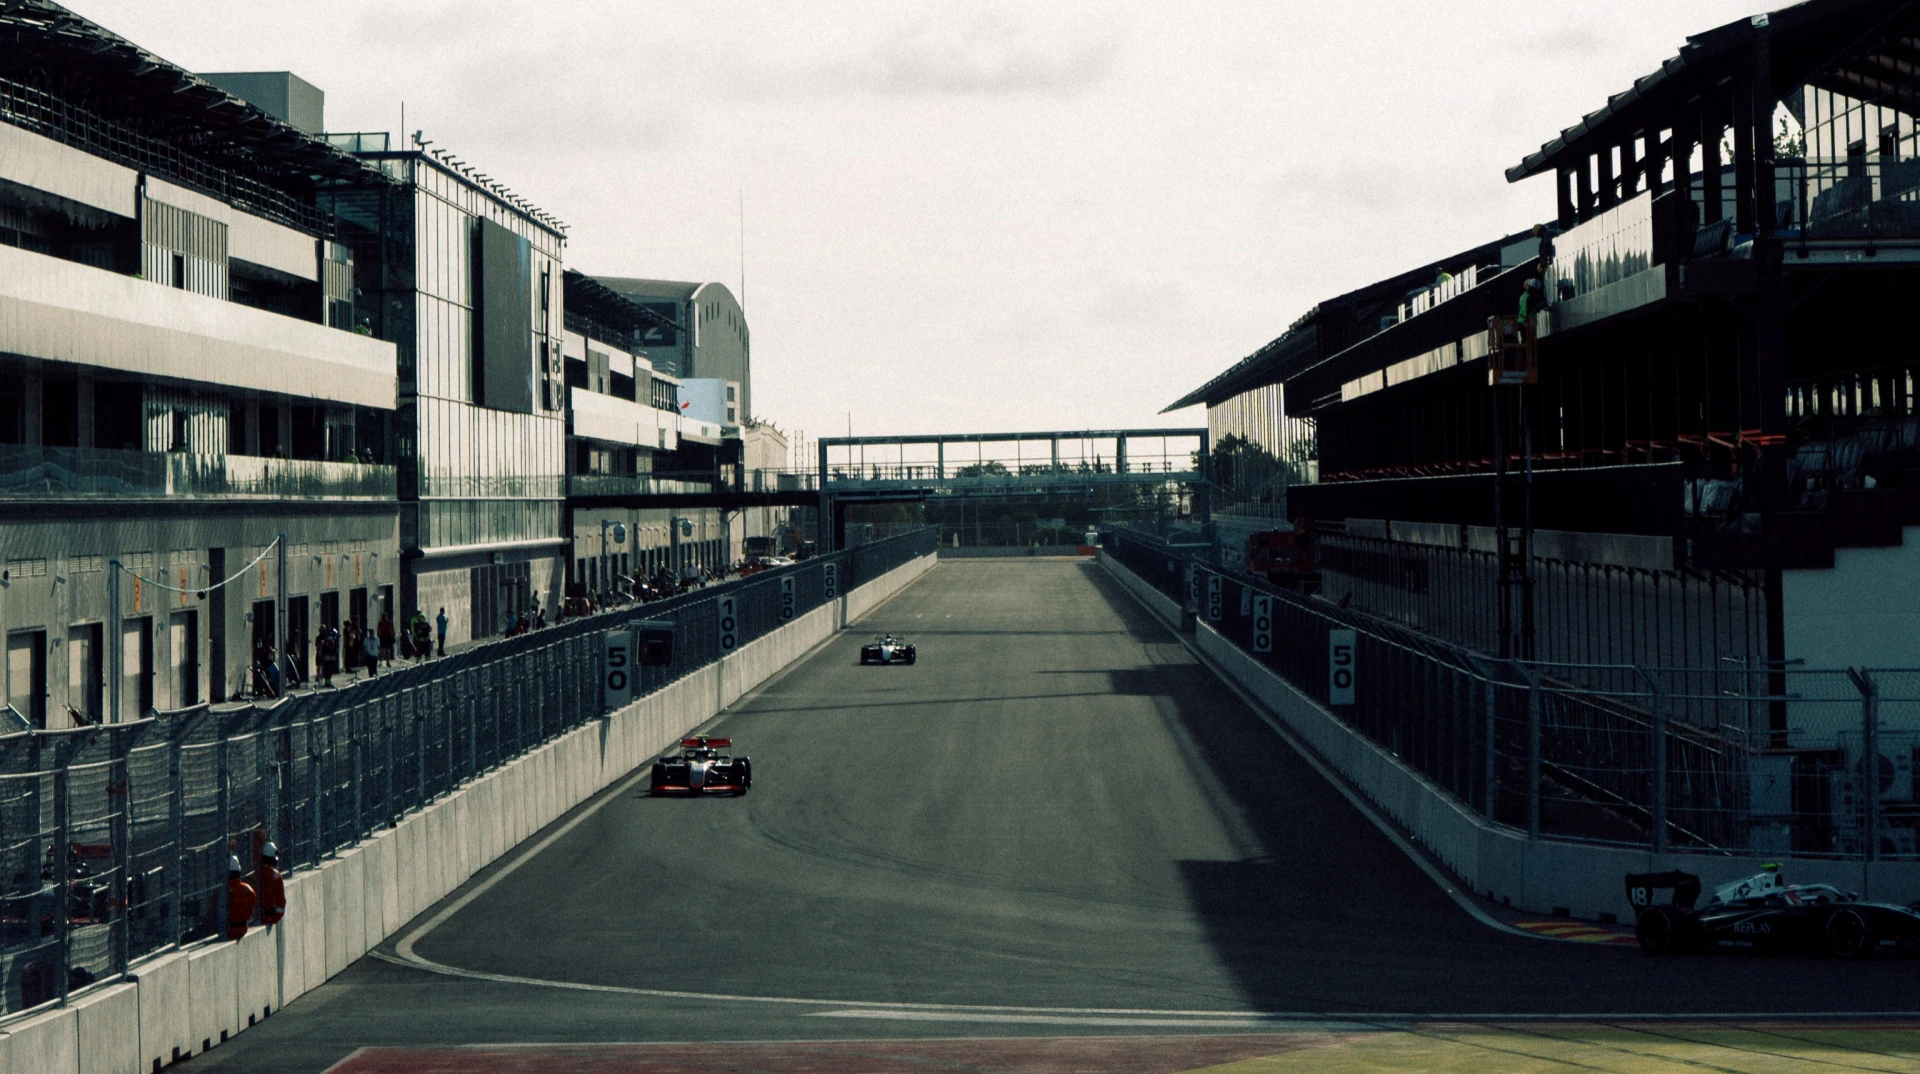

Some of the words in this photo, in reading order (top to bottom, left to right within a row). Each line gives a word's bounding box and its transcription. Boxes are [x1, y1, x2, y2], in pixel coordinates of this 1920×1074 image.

[783, 579, 793, 618] 150
[826, 565, 835, 598] 200
[1211, 578, 1221, 618] 150
[721, 599, 736, 649] 100
[1255, 599, 1270, 649] 100
[607, 646, 627, 691] 50
[1333, 645, 1352, 689] 50
[1631, 886, 1648, 906] 18
[1733, 921, 1773, 935] REPLAY
